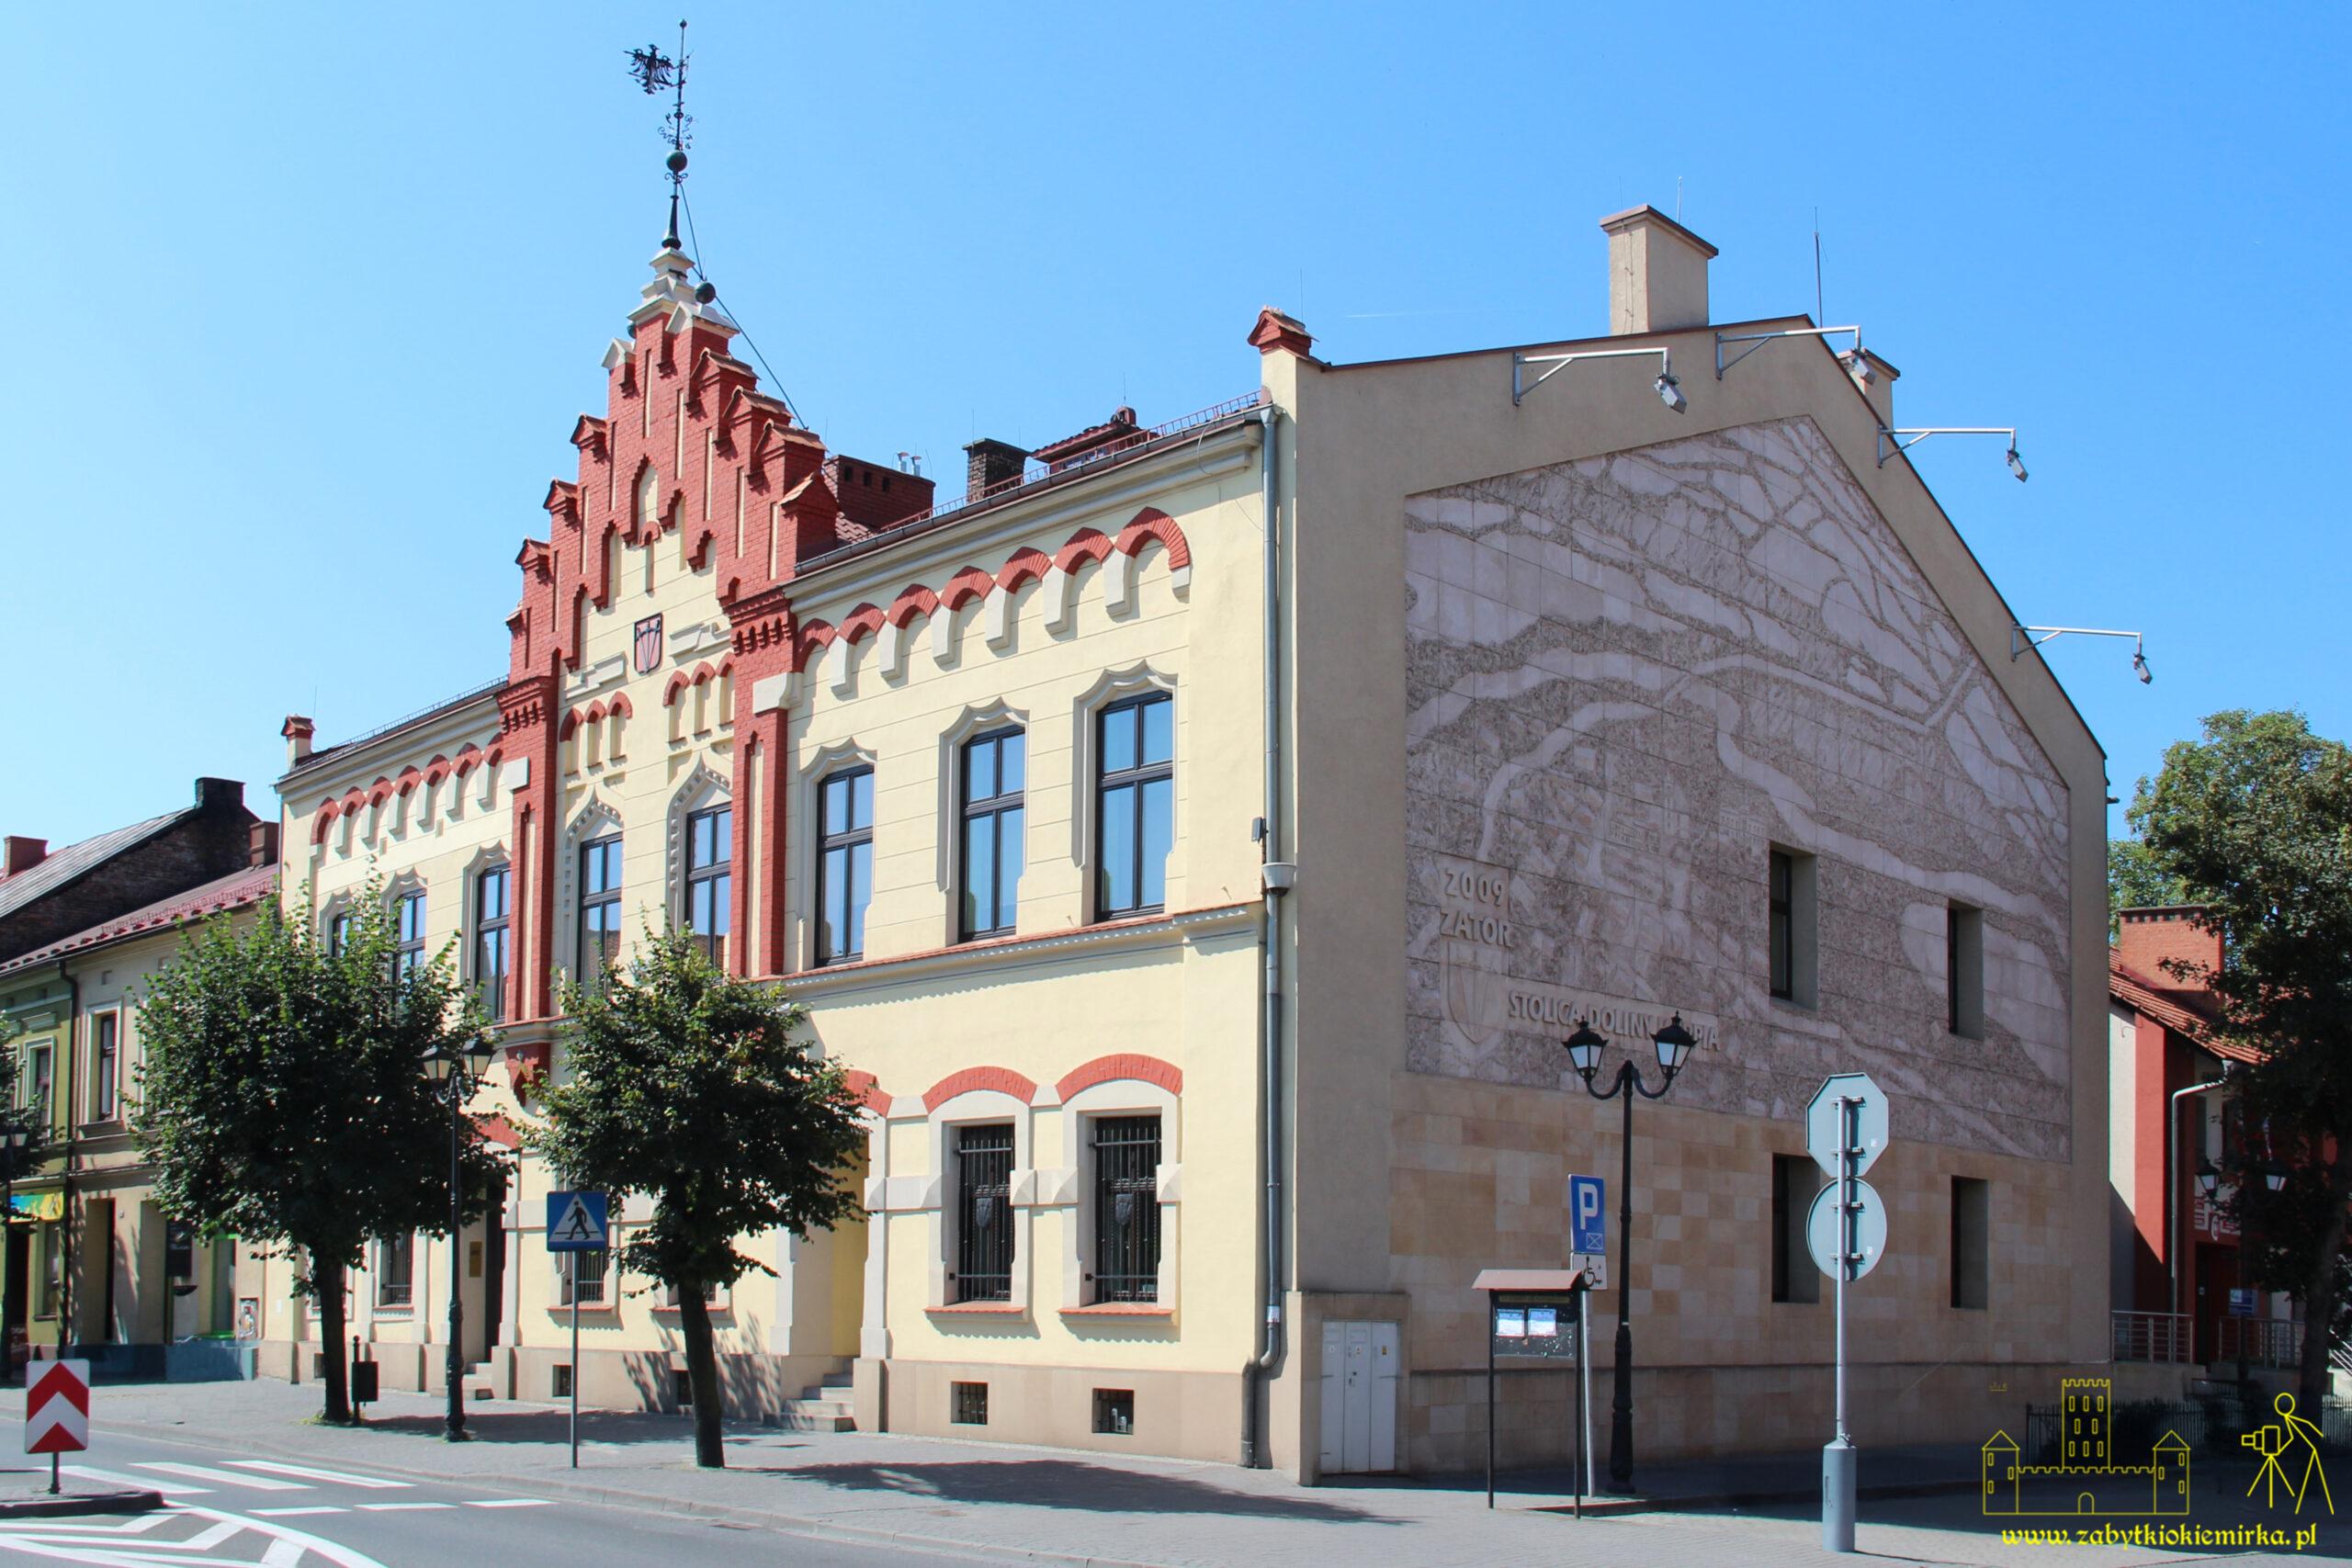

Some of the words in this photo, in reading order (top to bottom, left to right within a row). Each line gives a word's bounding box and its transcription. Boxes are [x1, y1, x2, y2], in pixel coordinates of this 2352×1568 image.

[1444, 868, 1504, 908] 2009
[1439, 909, 1515, 949] ZATOR
[1509, 989, 1580, 1027] STOLICA
[1587, 1002, 1655, 1040] DOLINY
[1657, 1015, 1721, 1051] KPIA
[1578, 1182, 1599, 1230] P
